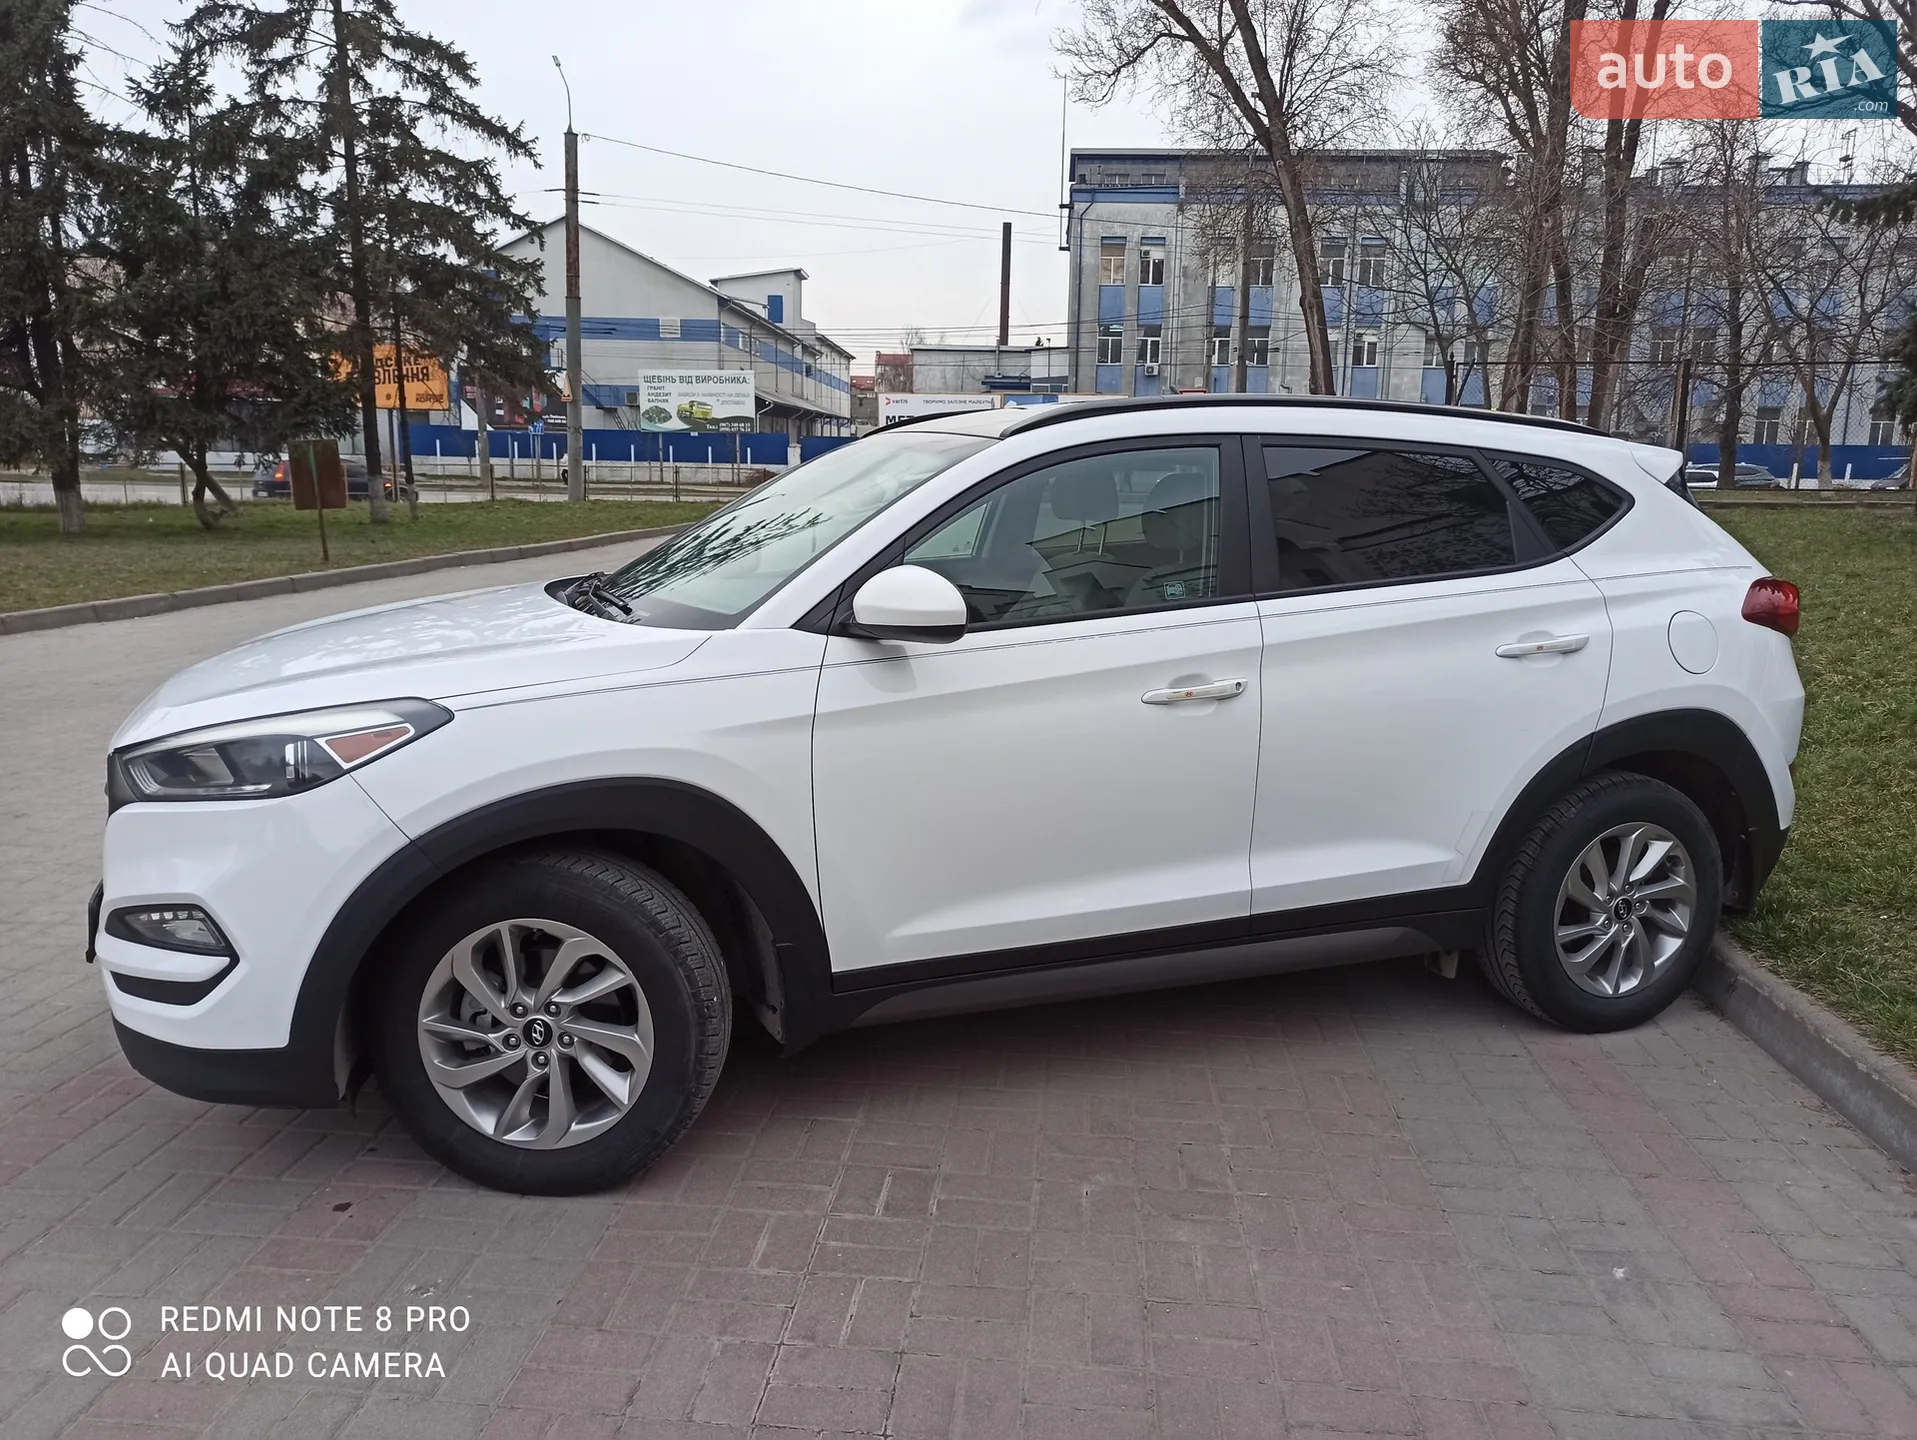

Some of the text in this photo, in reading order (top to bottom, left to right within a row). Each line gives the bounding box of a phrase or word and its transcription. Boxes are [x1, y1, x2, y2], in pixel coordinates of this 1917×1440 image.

[643, 375, 750, 385] ЩЕБІНЬ ВІД ВИРОБНИКА:
